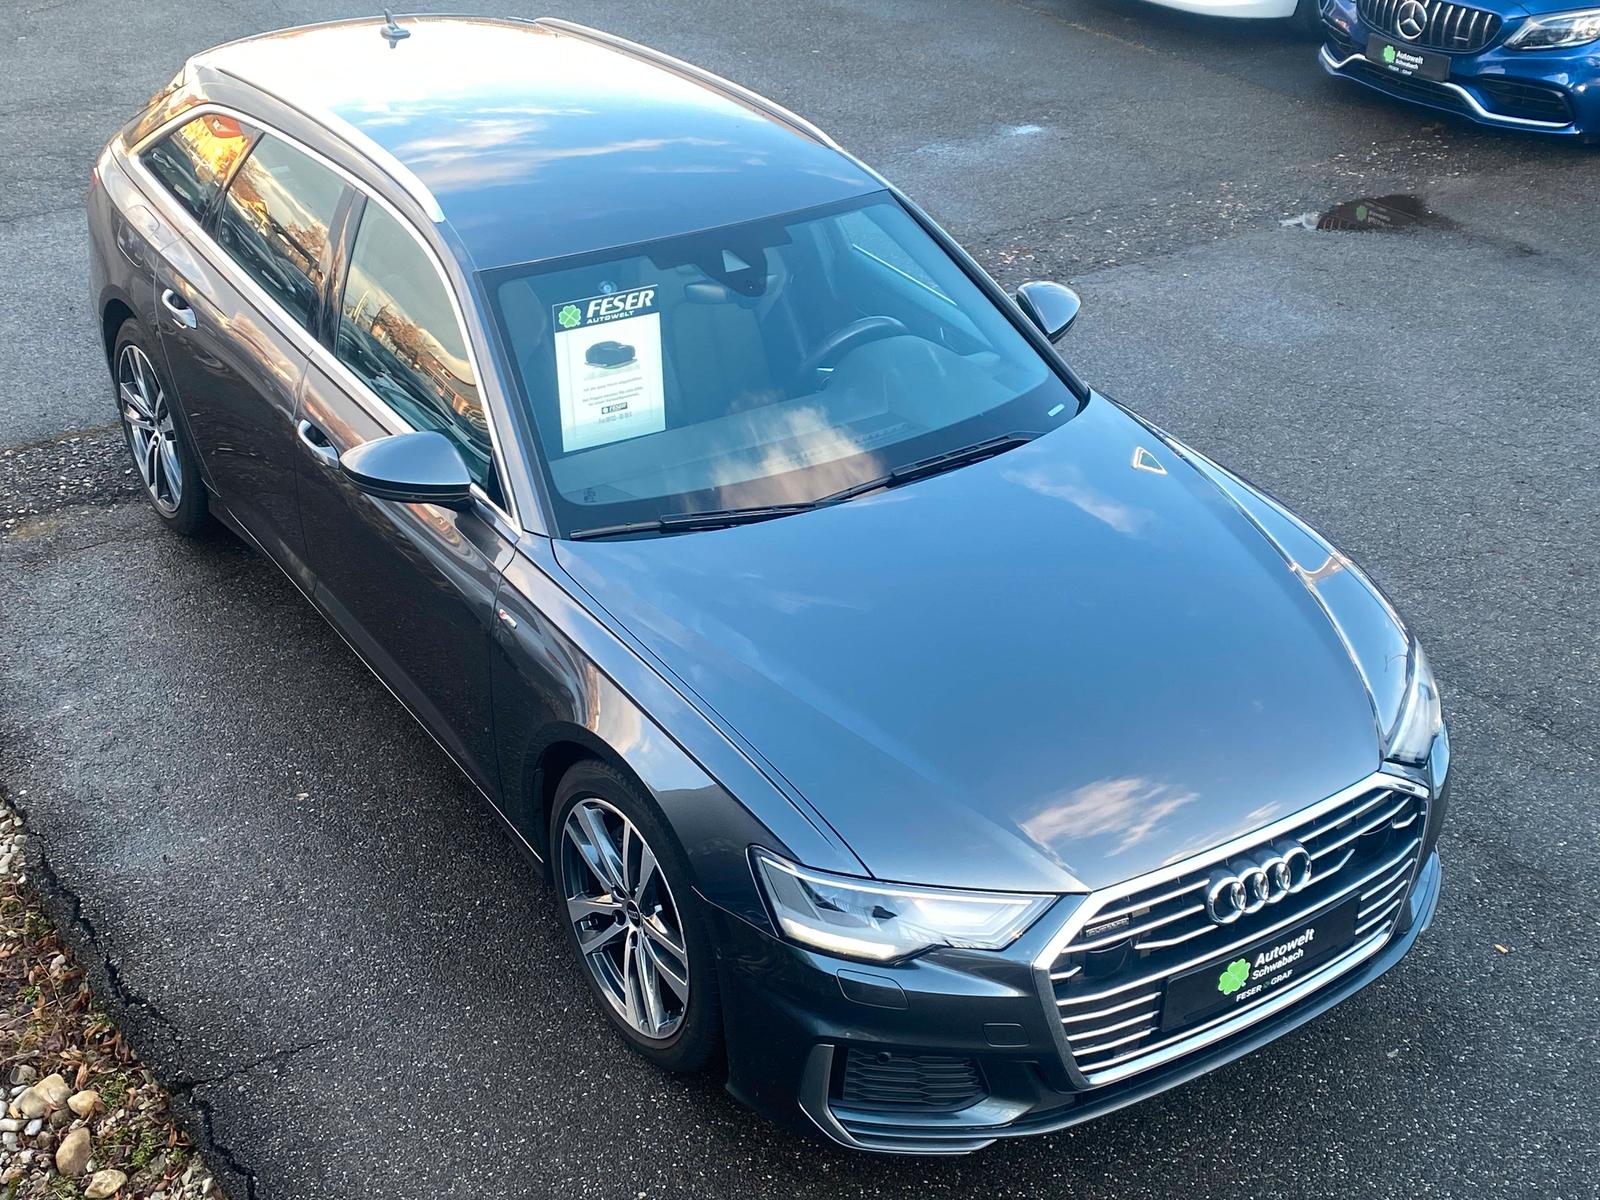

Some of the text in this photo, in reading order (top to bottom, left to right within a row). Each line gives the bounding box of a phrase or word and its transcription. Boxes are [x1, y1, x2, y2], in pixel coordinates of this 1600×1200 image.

[1396, 50, 1424, 65] Autowelt
[586, 289, 655, 319] FESER
[586, 310, 634, 324] AUTOWELT
[1254, 928, 1315, 968] Autowelt
[1251, 948, 1304, 980] Schwabach
[1236, 969, 1294, 1002] FESER GRAF
